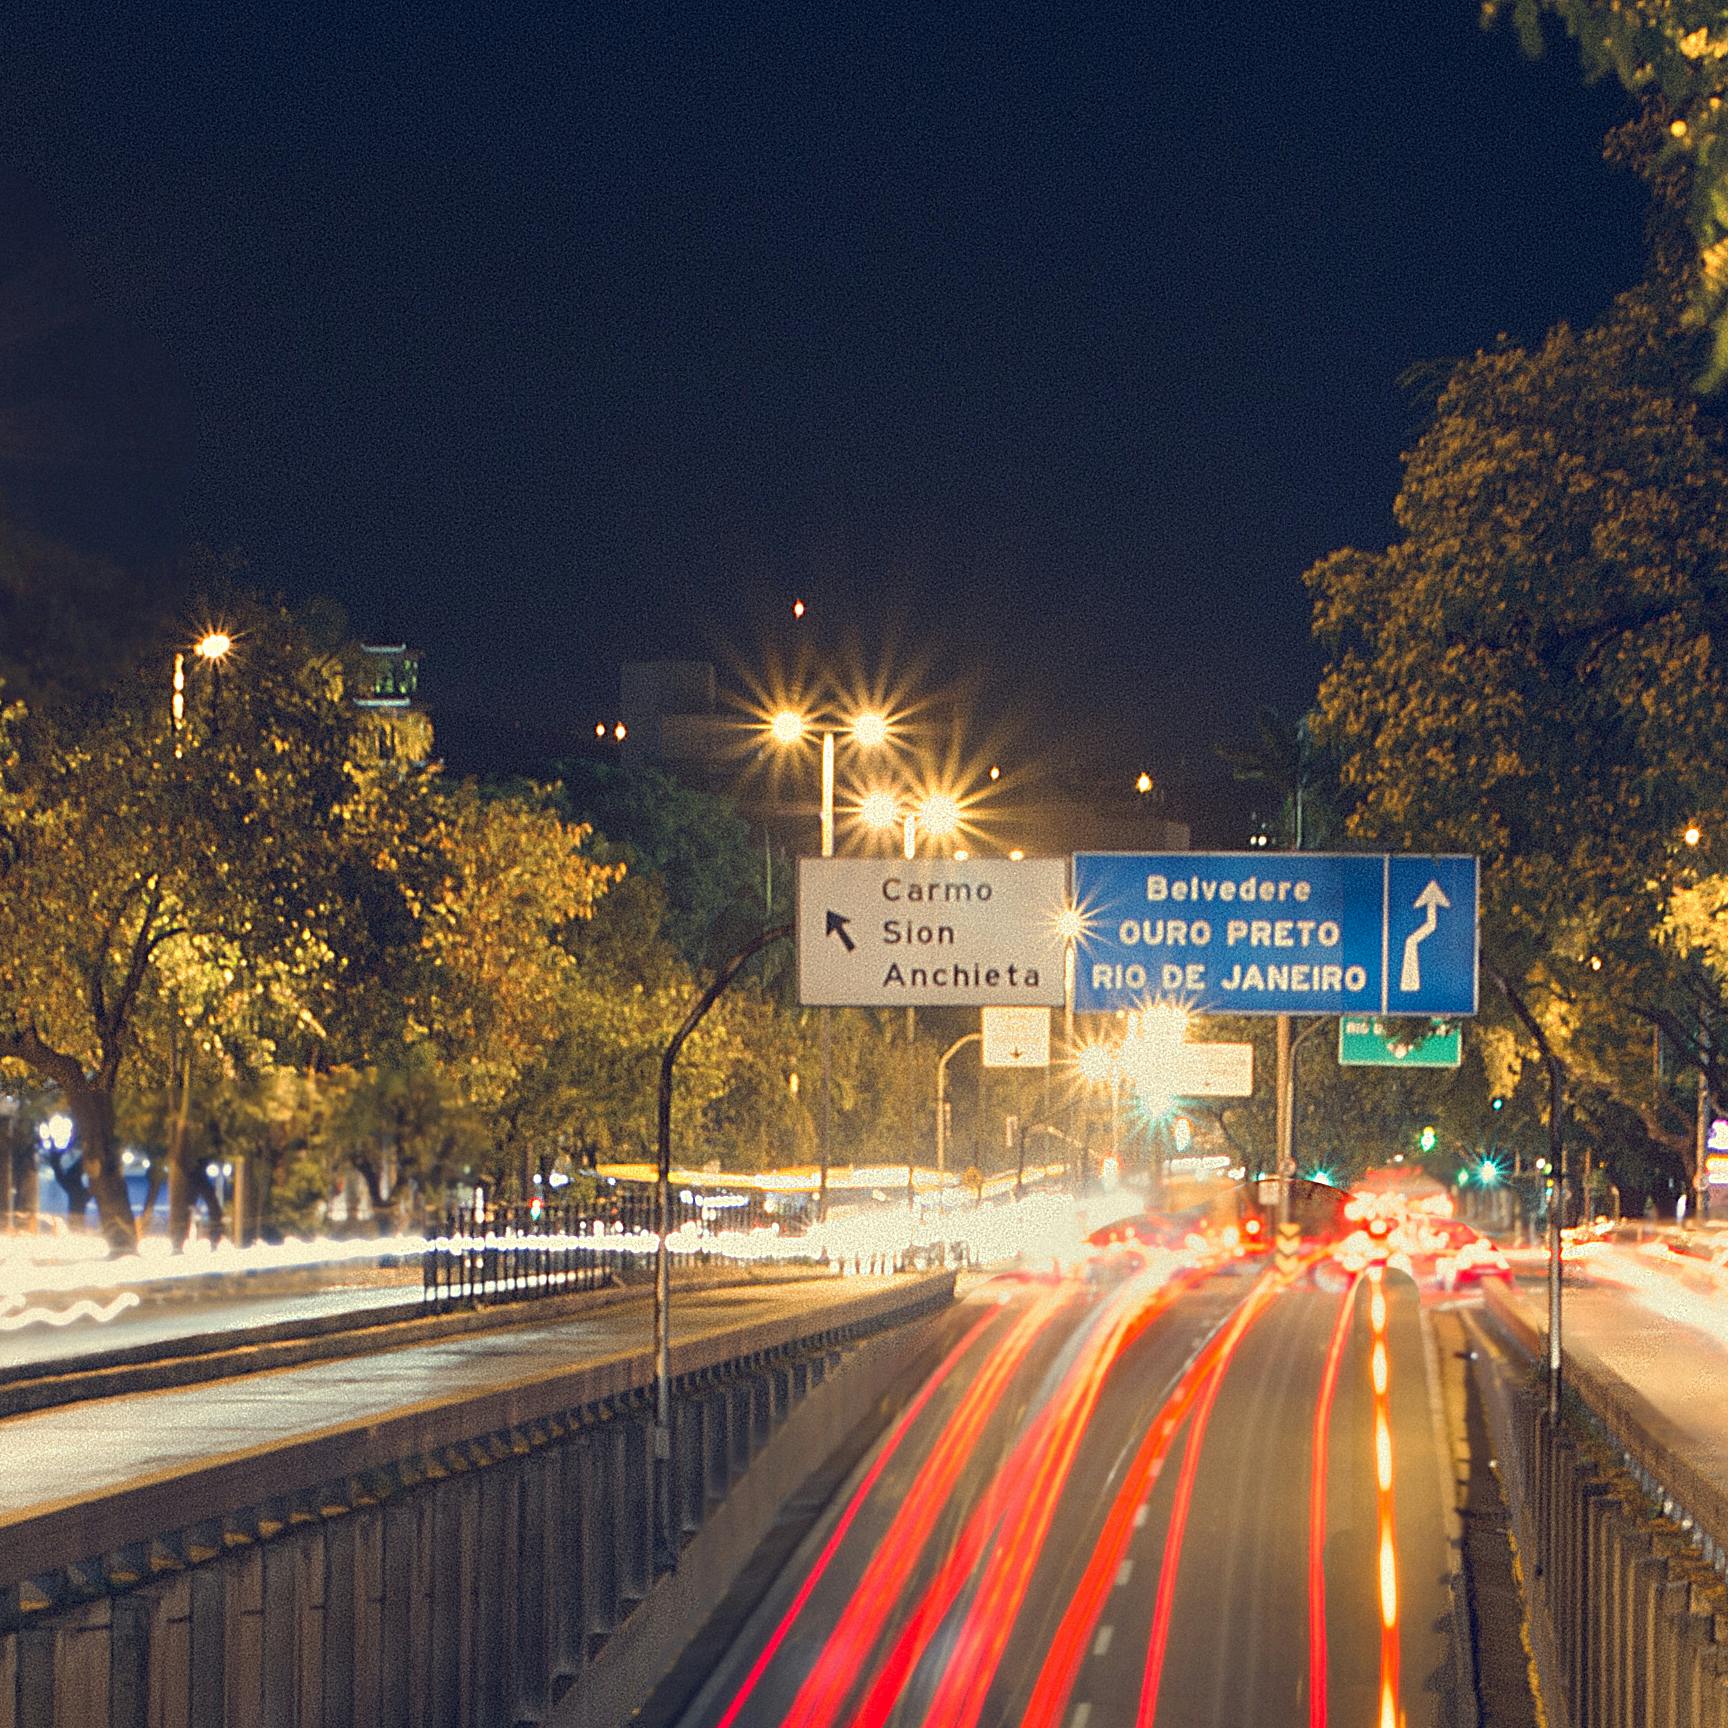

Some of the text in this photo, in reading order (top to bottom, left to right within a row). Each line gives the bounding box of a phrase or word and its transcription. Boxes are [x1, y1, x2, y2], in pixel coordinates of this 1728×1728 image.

[882, 877, 993, 902] Carmo
[1146, 874, 1312, 902] Belvedere
[882, 920, 955, 945] Sion
[1119, 919, 1341, 947] OURO PRETO
[882, 961, 1040, 988] Anchieta
[1091, 963, 1367, 992] RIO DE JANEIRO
